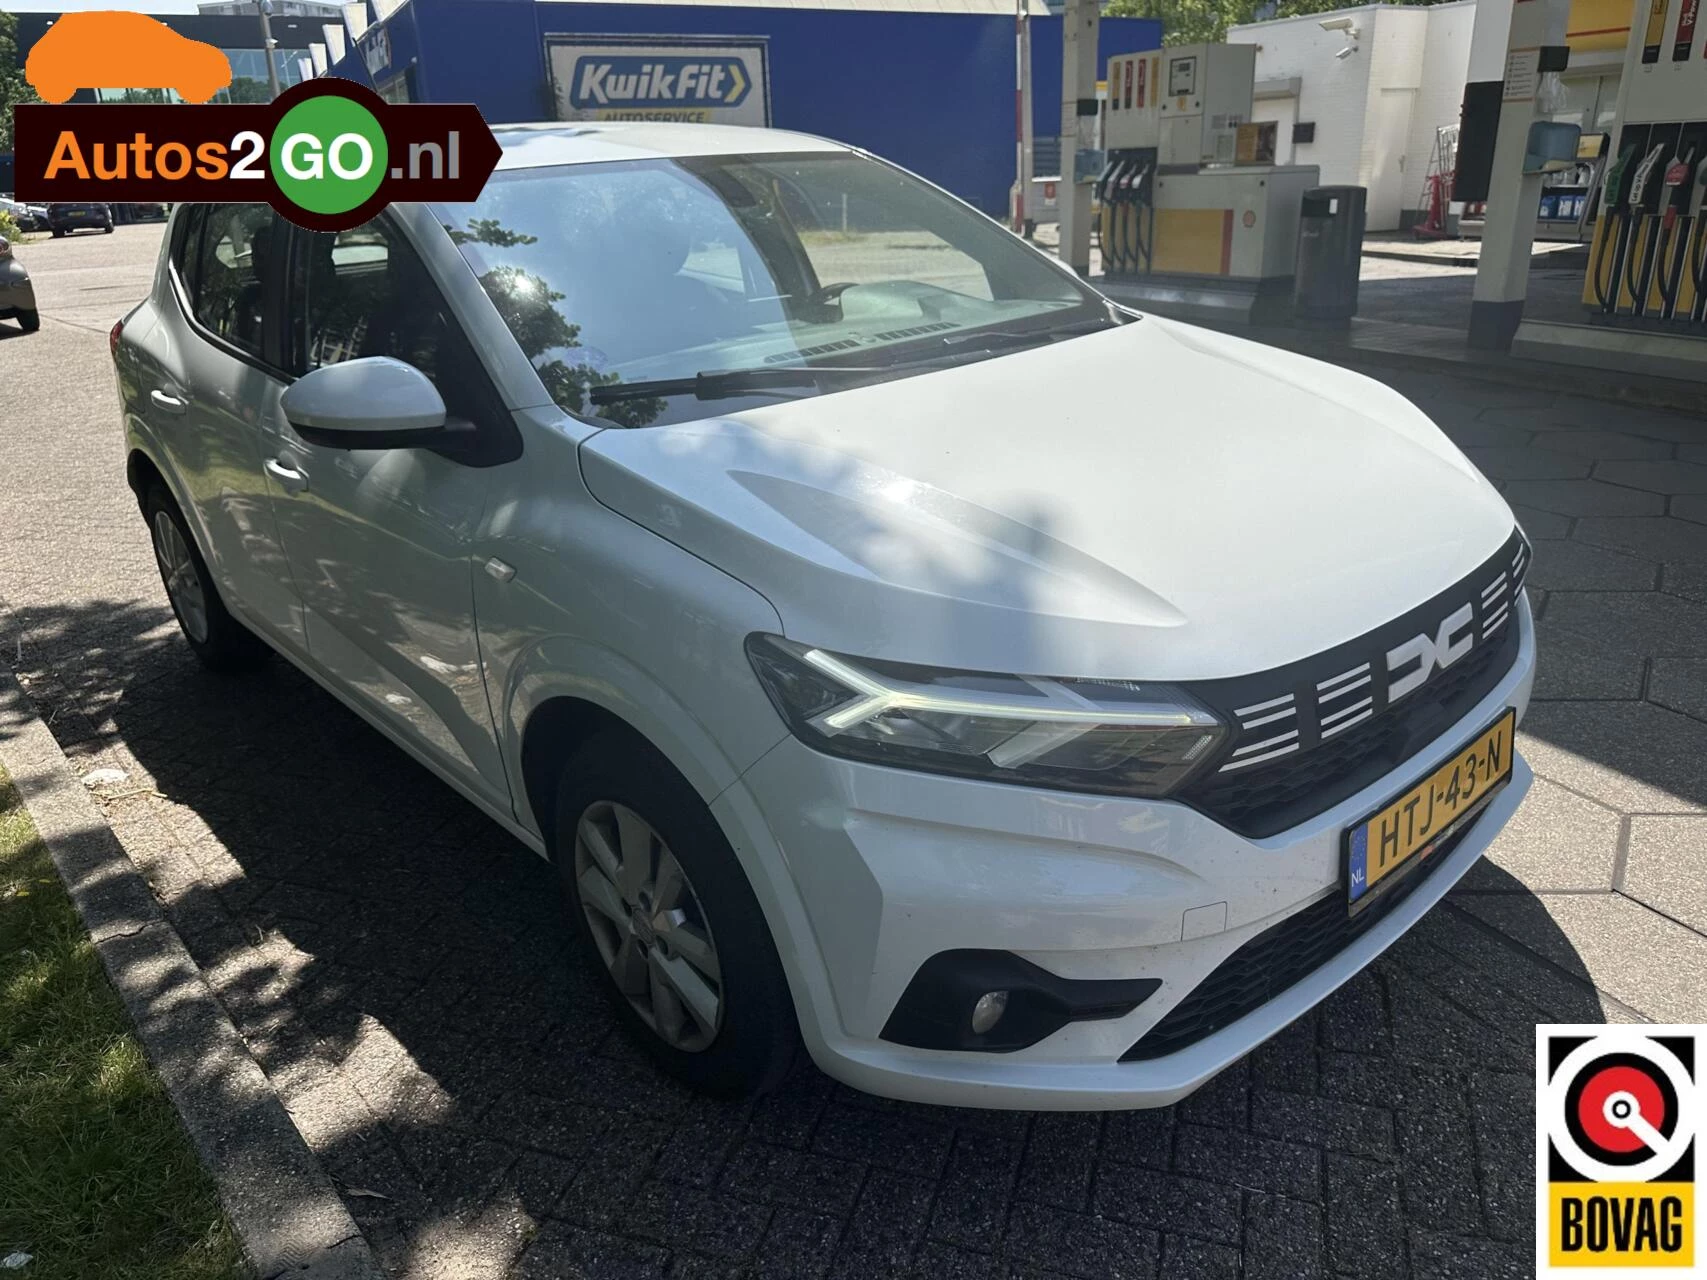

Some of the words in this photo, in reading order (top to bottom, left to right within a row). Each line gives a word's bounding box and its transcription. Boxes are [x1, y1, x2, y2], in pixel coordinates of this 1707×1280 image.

[604, 111, 705, 123] AUTOSERVICE
[1379, 730, 1502, 868] HTJ-43-N
[1351, 869, 1365, 888] NL
